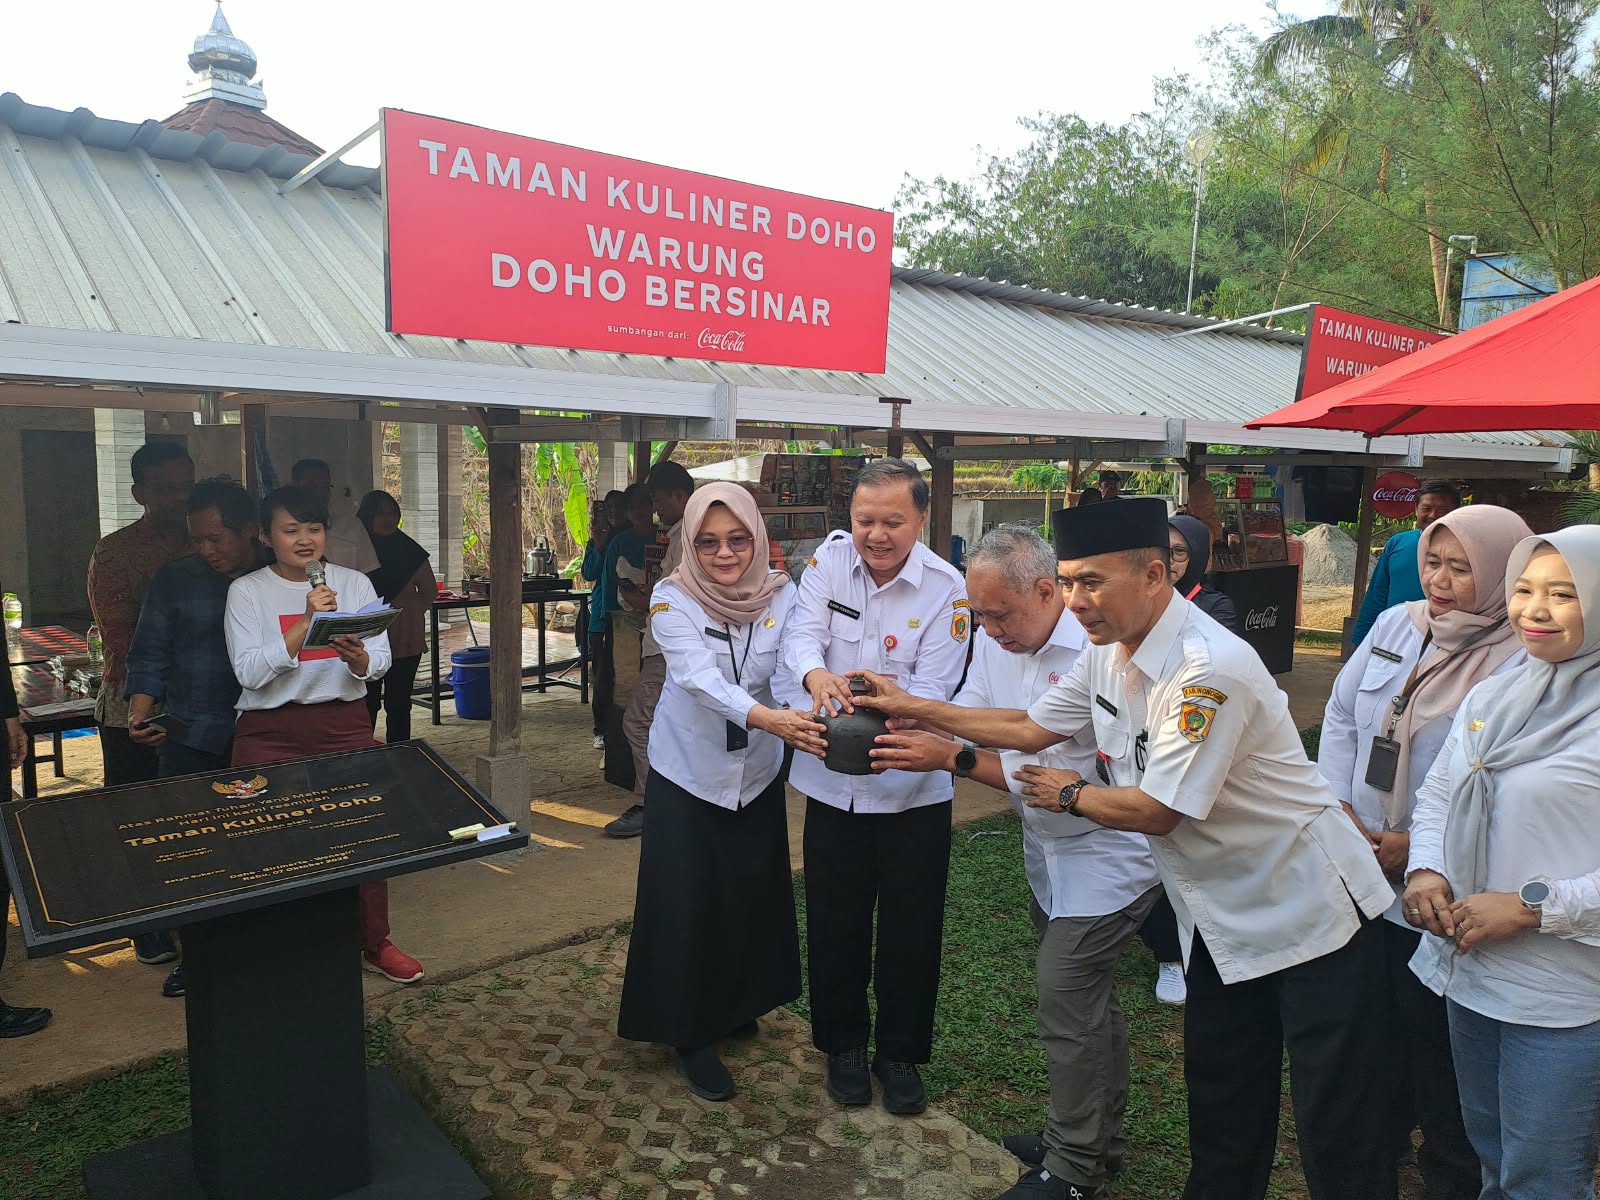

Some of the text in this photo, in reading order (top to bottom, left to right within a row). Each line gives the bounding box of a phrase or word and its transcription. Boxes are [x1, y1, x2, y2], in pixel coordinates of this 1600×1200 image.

[418, 139, 877, 254] TAMAN KULINER DOHO
[585, 223, 765, 281] WARUNG
[490, 252, 831, 327] DOHO BERSINAR
[607, 325, 690, 340] sumbangan dari:
[1319, 317, 1363, 342] TAMAN
[1365, 328, 1414, 353] KULINER
[118, 781, 370, 830] Atas Rahmat Tuhan Yang Maha Kuasa
[124, 795, 383, 847] Taman Kuliner Doho
[270, 795, 330, 810] resmikan
